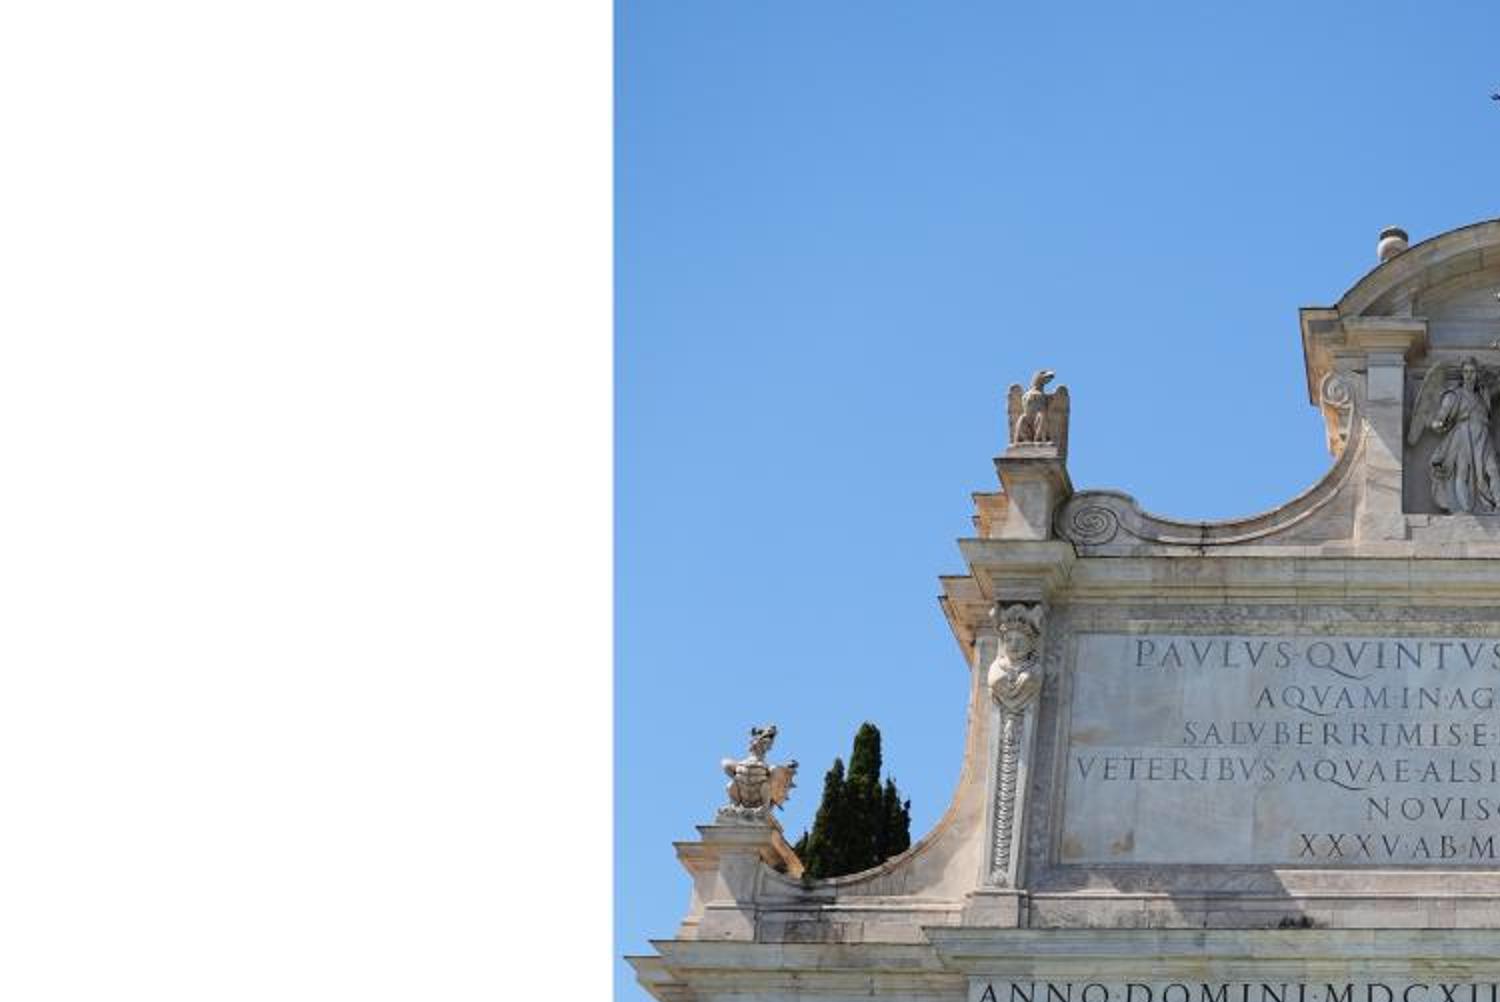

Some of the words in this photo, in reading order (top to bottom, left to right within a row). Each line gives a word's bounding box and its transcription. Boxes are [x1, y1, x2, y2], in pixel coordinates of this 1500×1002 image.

[1135, 639, 1292, 669] PAVLVS
[1255, 686, 1389, 717] AQVAM
[1402, 687, 1442, 709] IN
[1183, 721, 1461, 747] SALVBERRIMIS
[1473, 723, 1488, 747] E
[1077, 756, 1276, 782] VETERIBVS
[1288, 758, 1409, 791] AQVAE
[1300, 833, 1401, 858] XXXV
[1412, 834, 1457, 859] AB
